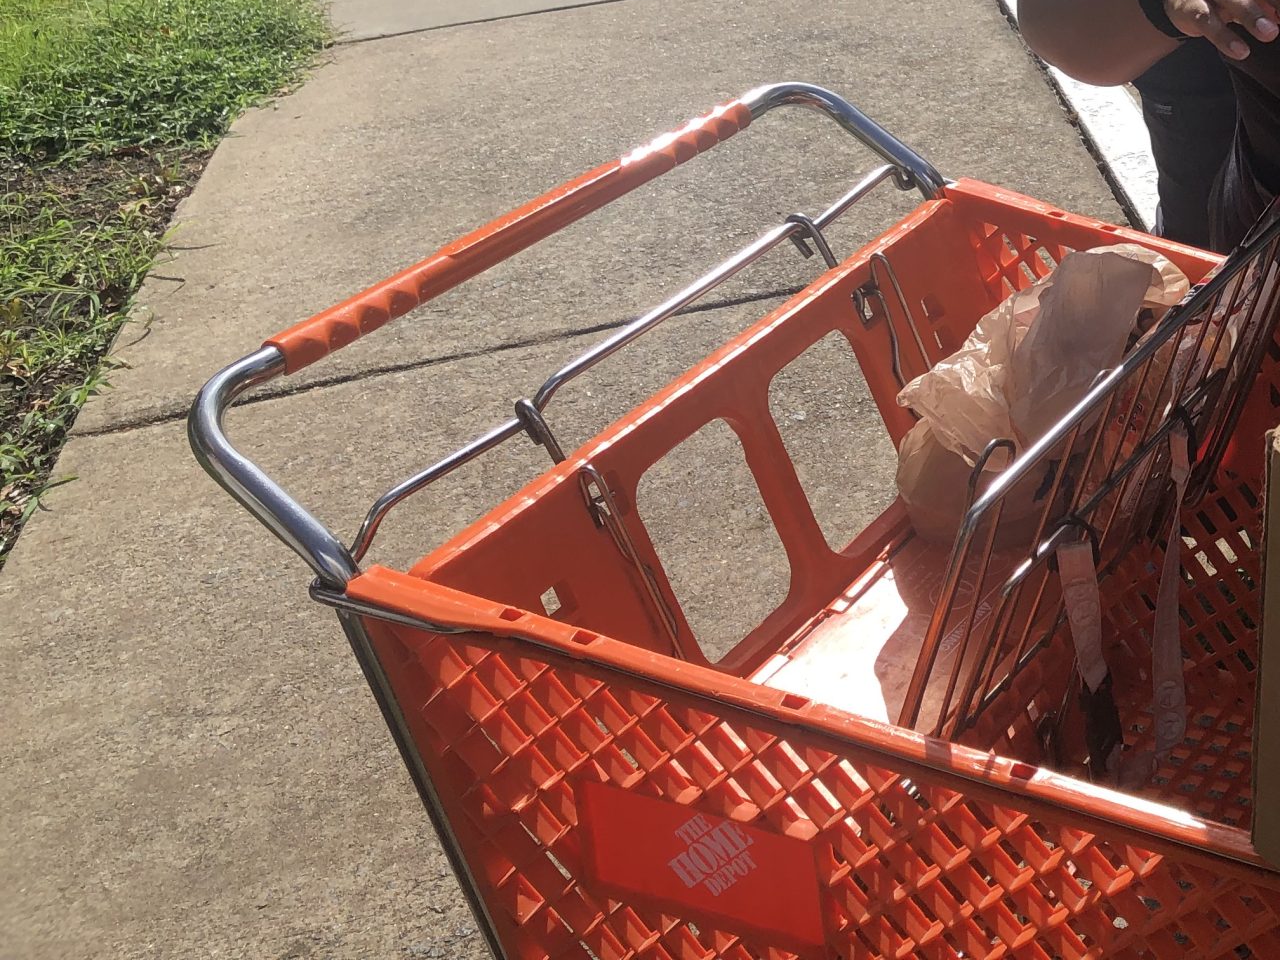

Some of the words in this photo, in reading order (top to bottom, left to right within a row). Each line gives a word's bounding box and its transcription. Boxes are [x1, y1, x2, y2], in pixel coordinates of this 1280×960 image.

[674, 812, 713, 846] THE
[667, 820, 754, 889] HOME
[703, 850, 758, 897] DEPOT
